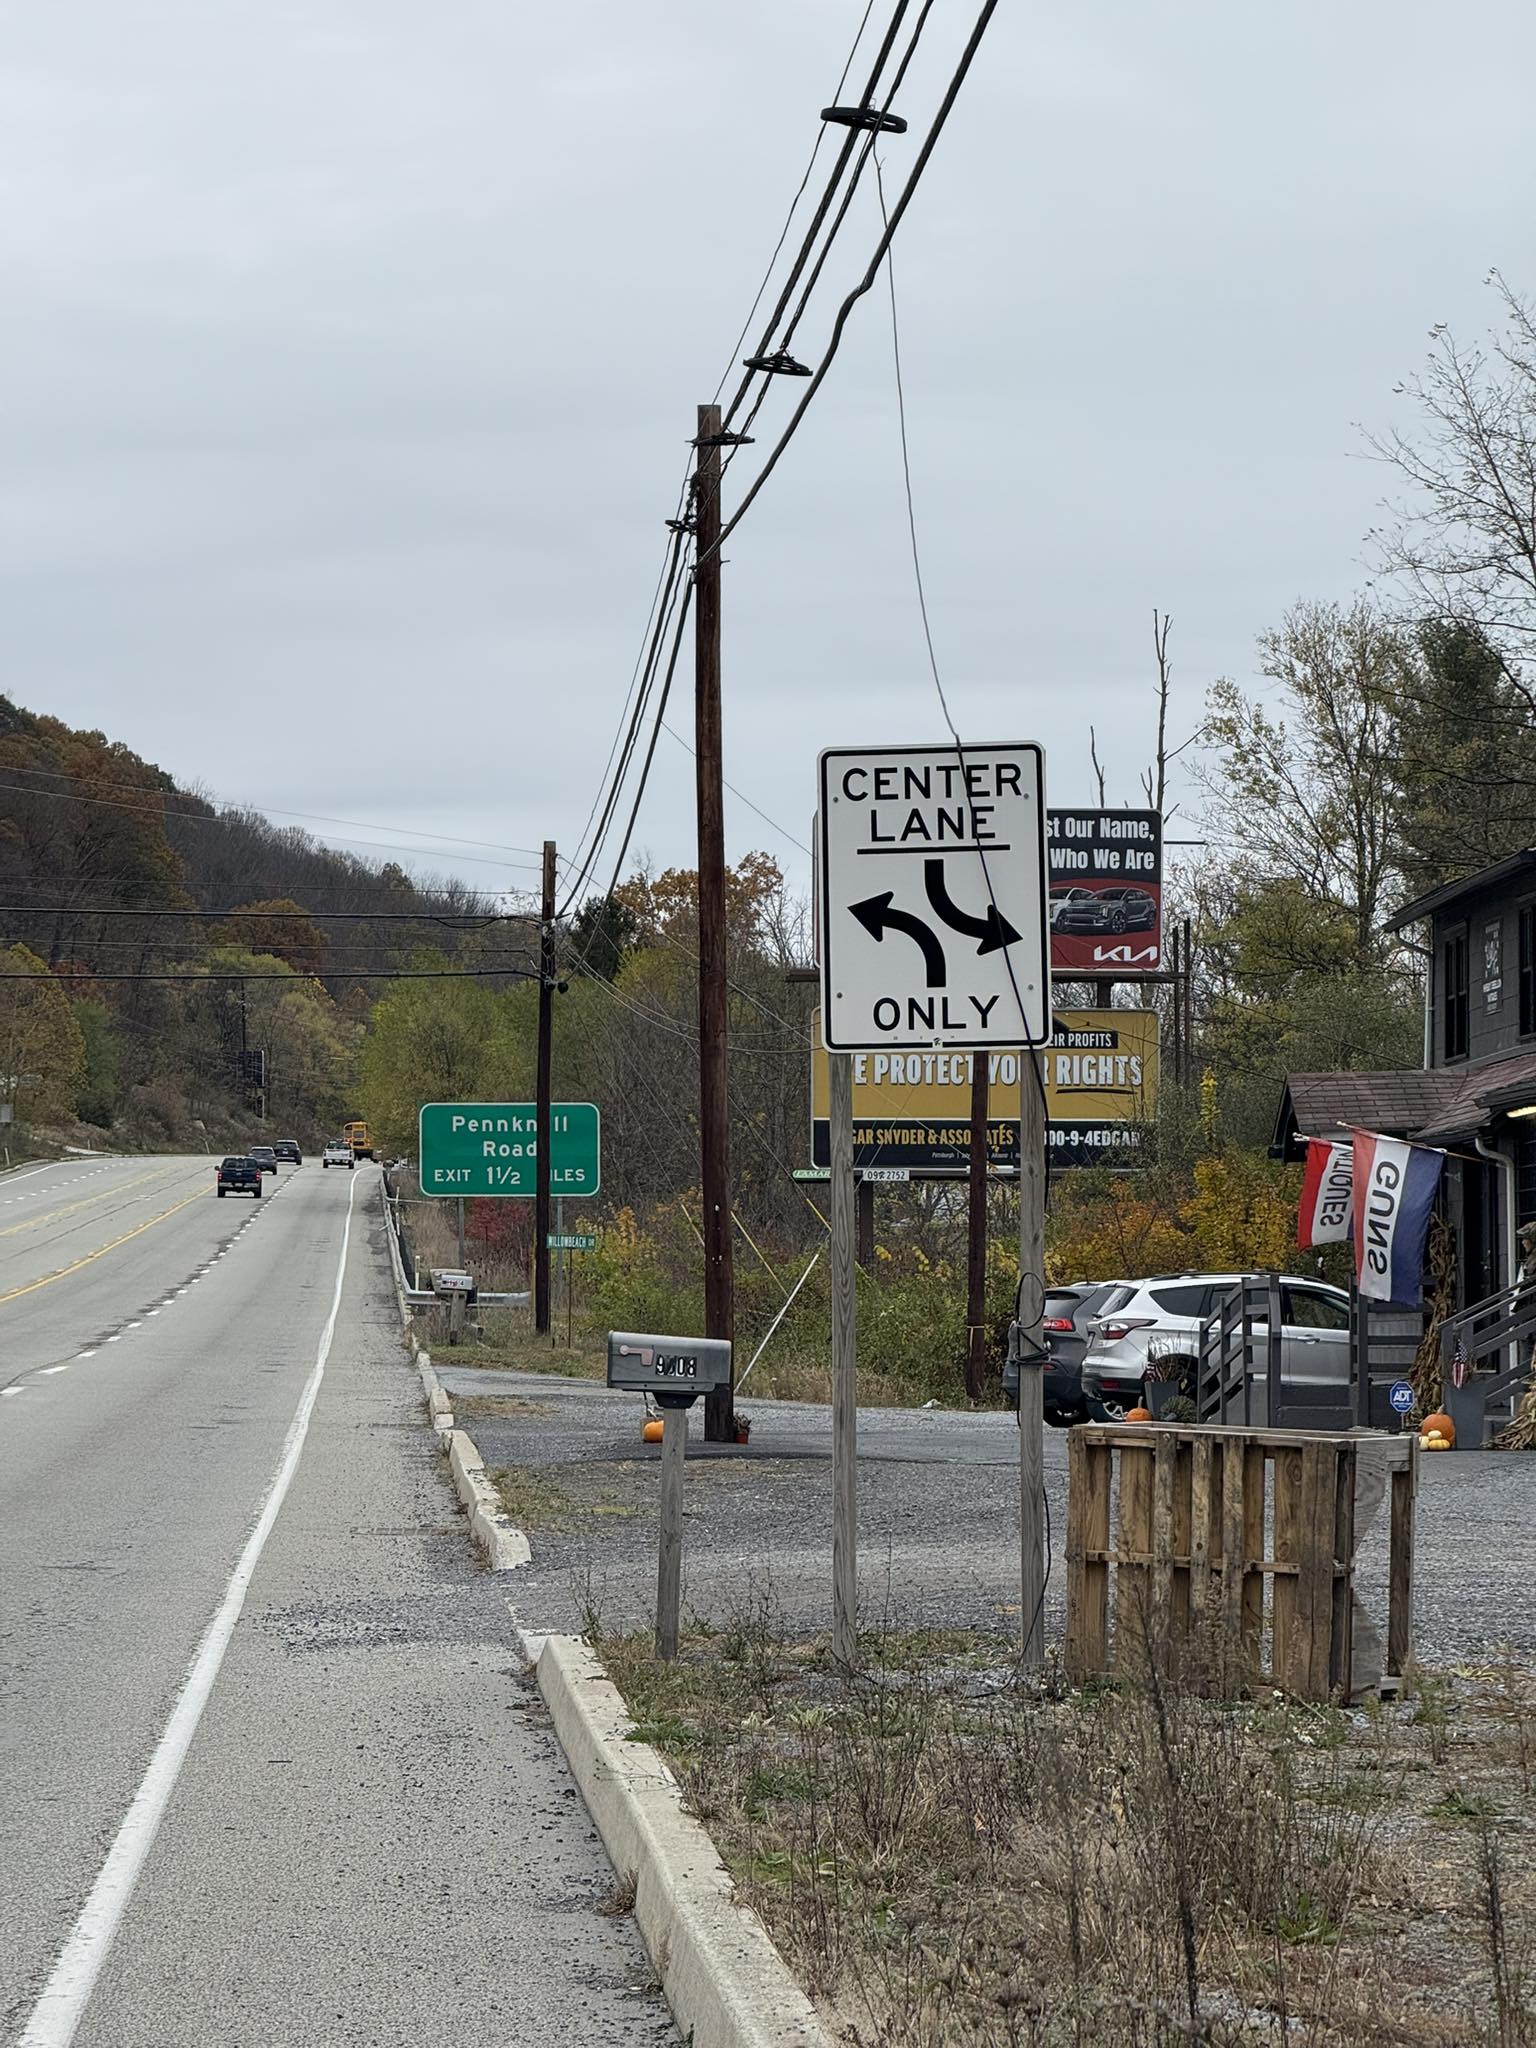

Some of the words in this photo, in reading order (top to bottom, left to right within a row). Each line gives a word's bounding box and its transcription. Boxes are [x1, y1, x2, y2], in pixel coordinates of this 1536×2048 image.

[842, 763, 1022, 802] CENTER
[870, 806, 996, 842] LANE
[1046, 817, 1060, 838] st
[1065, 817, 1095, 839] Our
[1099, 817, 1155, 842] Name,
[1049, 848, 1089, 869] Who
[1093, 848, 1121, 870] We
[1125, 848, 1155, 870] Are
[873, 995, 1000, 1032] ONLY
[1068, 1033, 1112, 1047] PROFITS
[873, 1054, 974, 1086] PROTECT
[1056, 1054, 1142, 1087] RIGHTS
[452, 1115, 568, 1133] Pennknll
[876, 1128, 926, 1145] SNYDER
[927, 1129, 938, 1145] &
[939, 1127, 1014, 1146] ASSOATES
[483, 1140, 538, 1158] Road
[434, 1169, 472, 1182] EXIT
[550, 1168, 586, 1182] ILES
[1393, 1390, 1411, 1402] ADT
